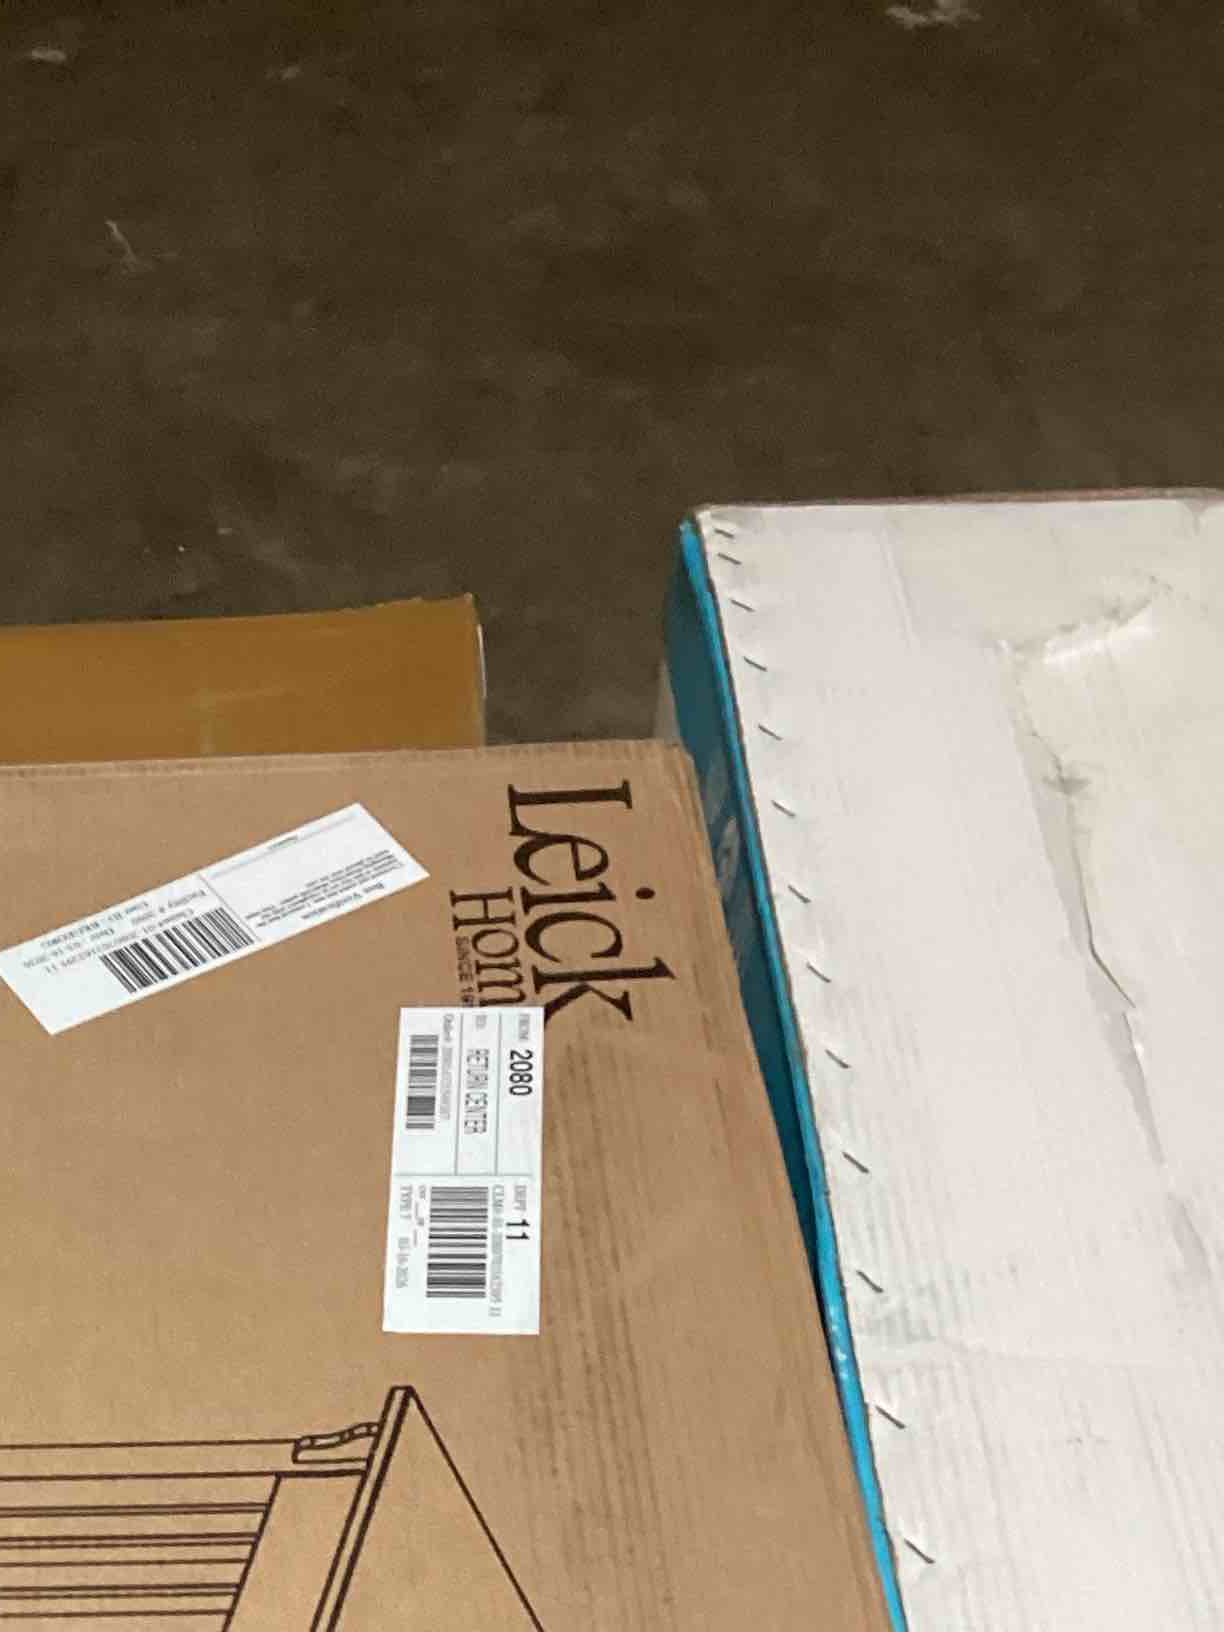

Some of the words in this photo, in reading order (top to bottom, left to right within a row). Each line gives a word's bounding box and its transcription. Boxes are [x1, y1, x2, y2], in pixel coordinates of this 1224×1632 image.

[507, 780, 677, 1027] Leick
[450, 886, 525, 1007] Hom
[456, 936, 473, 982] SINCE
[466, 1048, 489, 1089] RETURN
[509, 1049, 534, 1096] 2080
[464, 1092, 488, 1134] CENTER
[506, 1219, 530, 1240] 11
